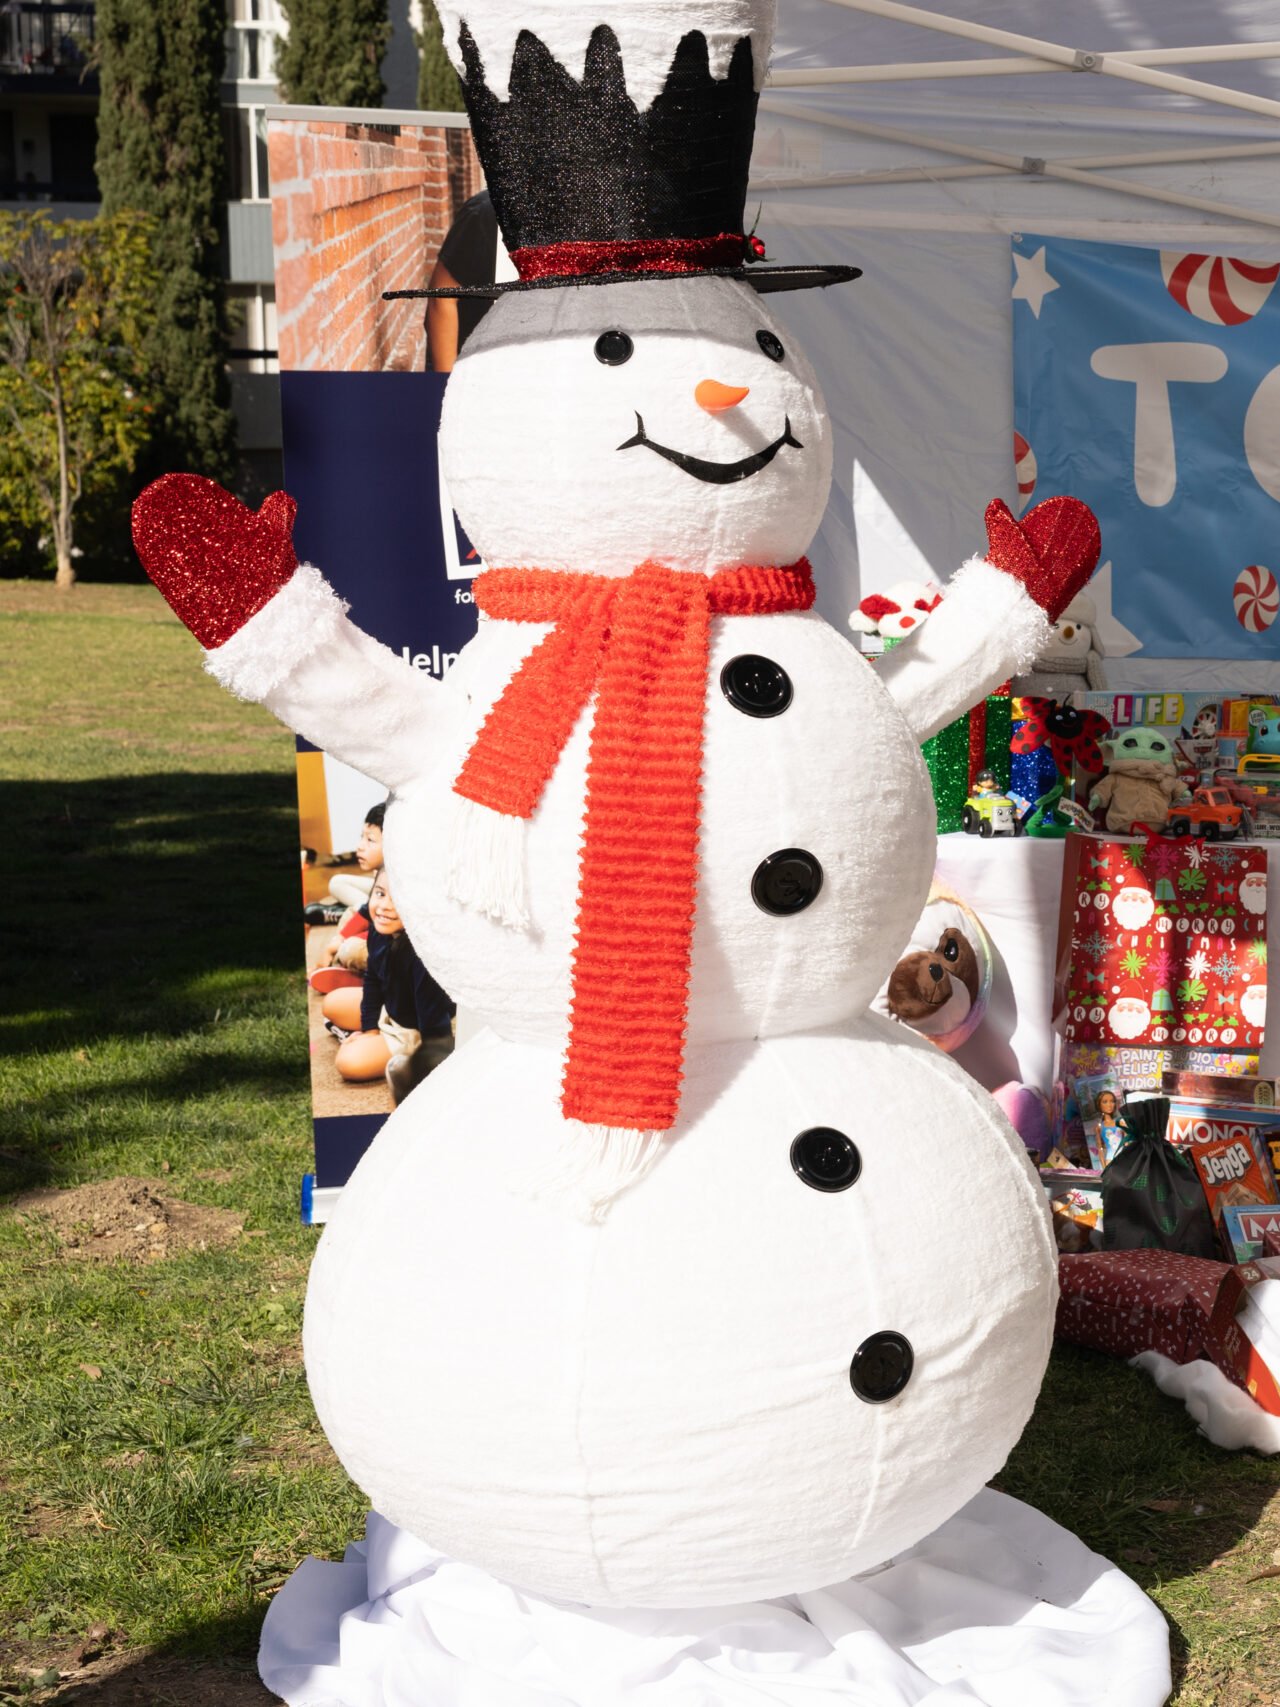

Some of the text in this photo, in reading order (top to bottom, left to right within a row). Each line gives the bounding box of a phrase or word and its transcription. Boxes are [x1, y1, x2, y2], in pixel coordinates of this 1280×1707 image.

[1117, 697, 1179, 723] LIFE
[1116, 932, 1237, 951] CHRITMAS
[1120, 1050, 1212, 1065] PAINT STUDIO
[1107, 1062, 1158, 1076] ATELIER
[1119, 1077, 1157, 1090] TUDIO
[1199, 1141, 1252, 1185] Jenga
[1243, 1269, 1259, 1281] 24
